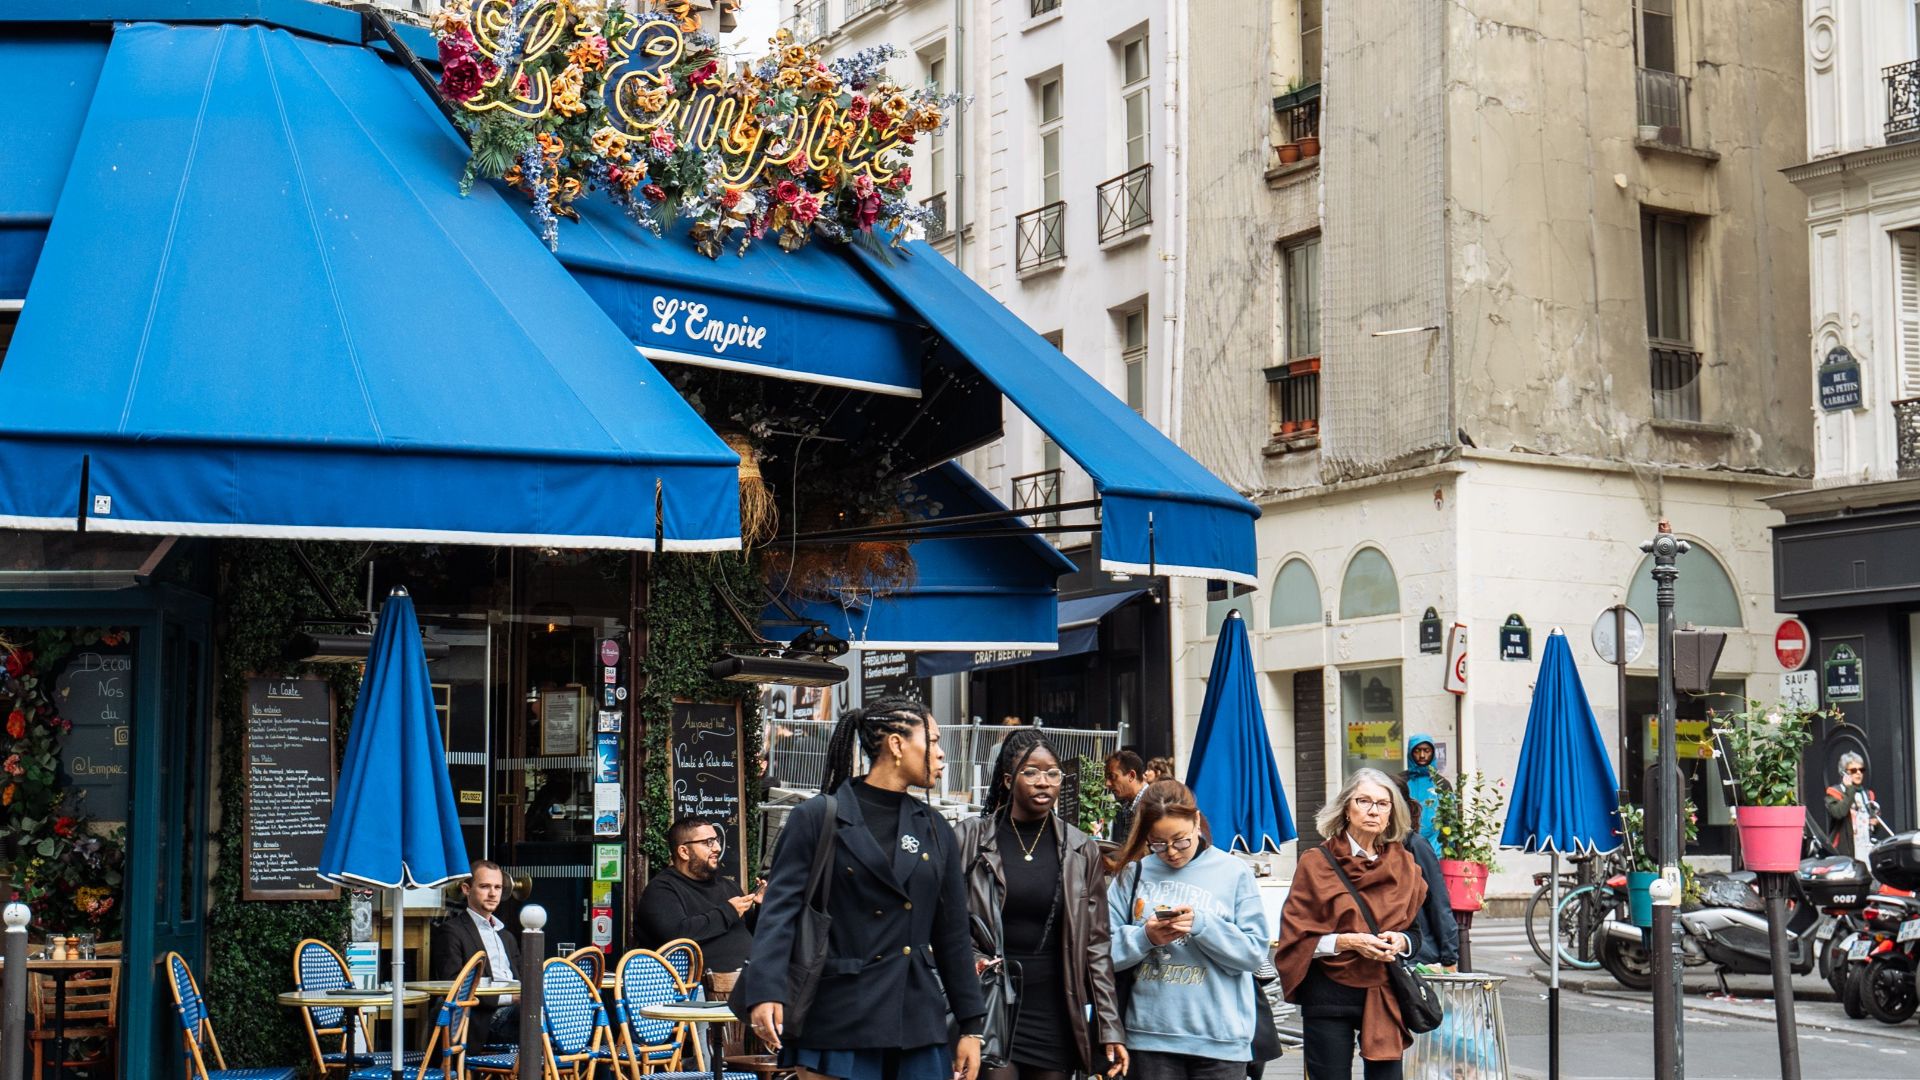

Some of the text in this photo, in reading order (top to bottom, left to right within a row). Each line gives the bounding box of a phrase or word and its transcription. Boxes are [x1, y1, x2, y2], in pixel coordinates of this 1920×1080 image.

[651, 295, 767, 353] L'Empire
[1833, 372, 1847, 382] RUE
[1822, 382, 1858, 395] DES PETITS
[1824, 393, 1858, 406] CARREAUX
[1510, 634, 1520, 642] RUE
[1507, 646, 1524, 654] DU NIL
[974, 650, 996, 664] CRAFT
[998, 650, 1016, 661] BEER
[1785, 674, 1808, 685] SAUF
[98, 678, 124, 698] Nos
[268, 682, 300, 696] La Carte
[101, 704, 119, 720] du
[675, 743, 697, 768] Velouté
[698, 758, 704, 768] de
[721, 755, 734, 768] douce
[600, 847, 618, 855] Carte
[1833, 895, 1857, 904] 0087
